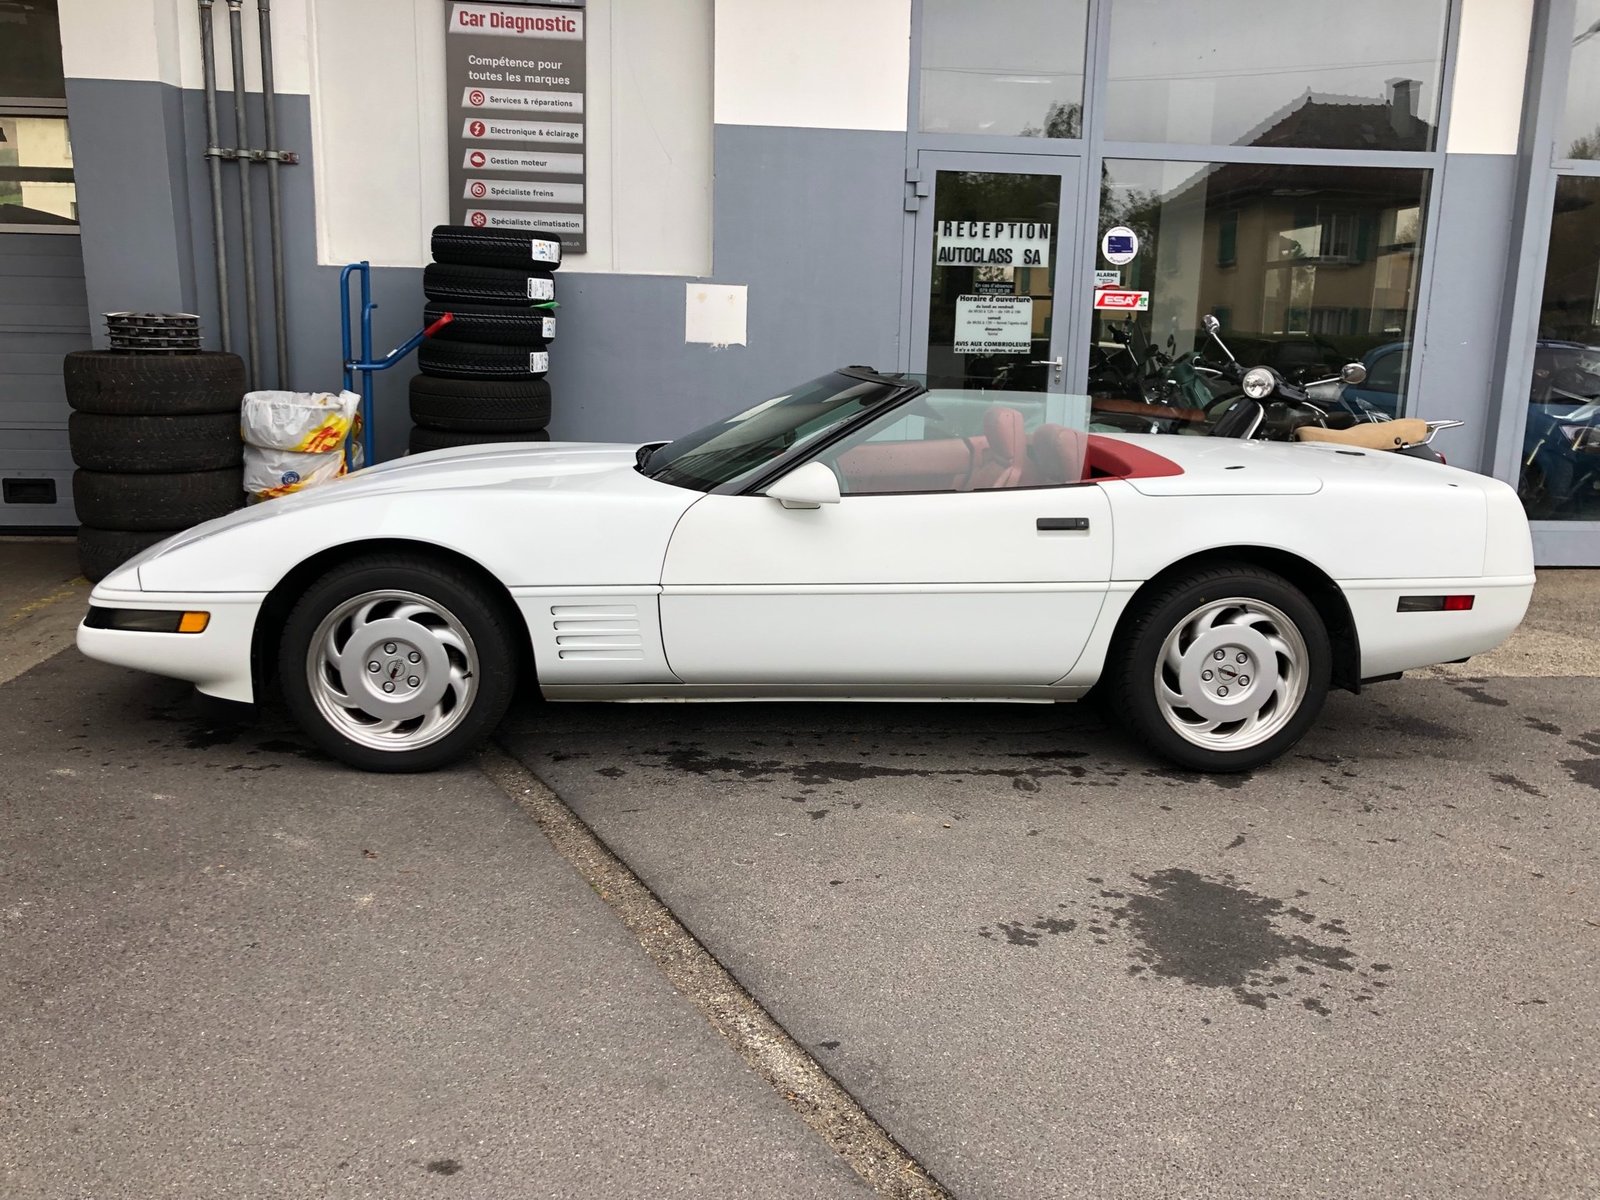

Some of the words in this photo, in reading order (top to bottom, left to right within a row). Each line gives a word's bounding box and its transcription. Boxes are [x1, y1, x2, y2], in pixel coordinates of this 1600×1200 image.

[459, 11, 486, 27] Car
[490, 12, 576, 33] Diagnostic
[468, 55, 535, 68] Compétence
[538, 61, 562, 70] pour
[469, 70, 503, 81] toutes
[506, 72, 521, 82] les
[525, 76, 570, 86] marques
[490, 96, 522, 105] Services
[531, 98, 573, 107] réparations
[490, 127, 537, 137] Electronique
[546, 129, 579, 139] éclairage
[490, 157, 519, 166] Gestion
[491, 187, 531, 197] Spécialiste
[533, 189, 554, 197] freins
[491, 217, 531, 227] Spécialiste
[533, 218, 579, 228] climatisation
[943, 221, 1048, 239] RECEPTION
[938, 247, 1013, 264] AUTOCLASS
[1023, 249, 1041, 265] SA
[988, 295, 1031, 303] d'ouverture
